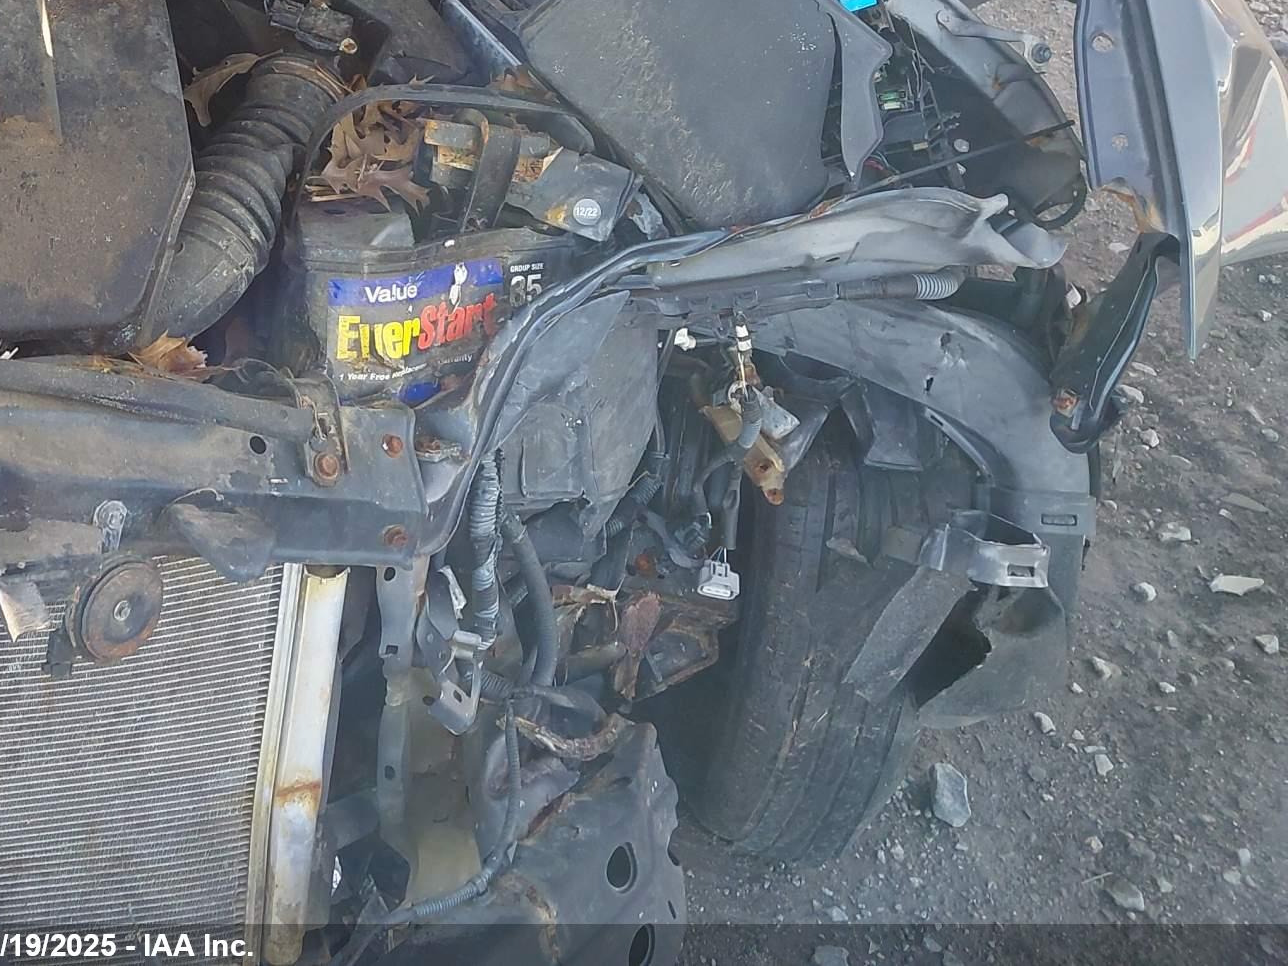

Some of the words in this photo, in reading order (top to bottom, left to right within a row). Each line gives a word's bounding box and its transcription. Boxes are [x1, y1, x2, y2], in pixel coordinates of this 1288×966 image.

[576, 206, 599, 218] 12/22
[510, 264, 530, 273] GROUP
[531, 262, 544, 271] SIZE
[364, 283, 418, 304] Value
[347, 373, 367, 381] Year
[370, 373, 390, 381] Free
